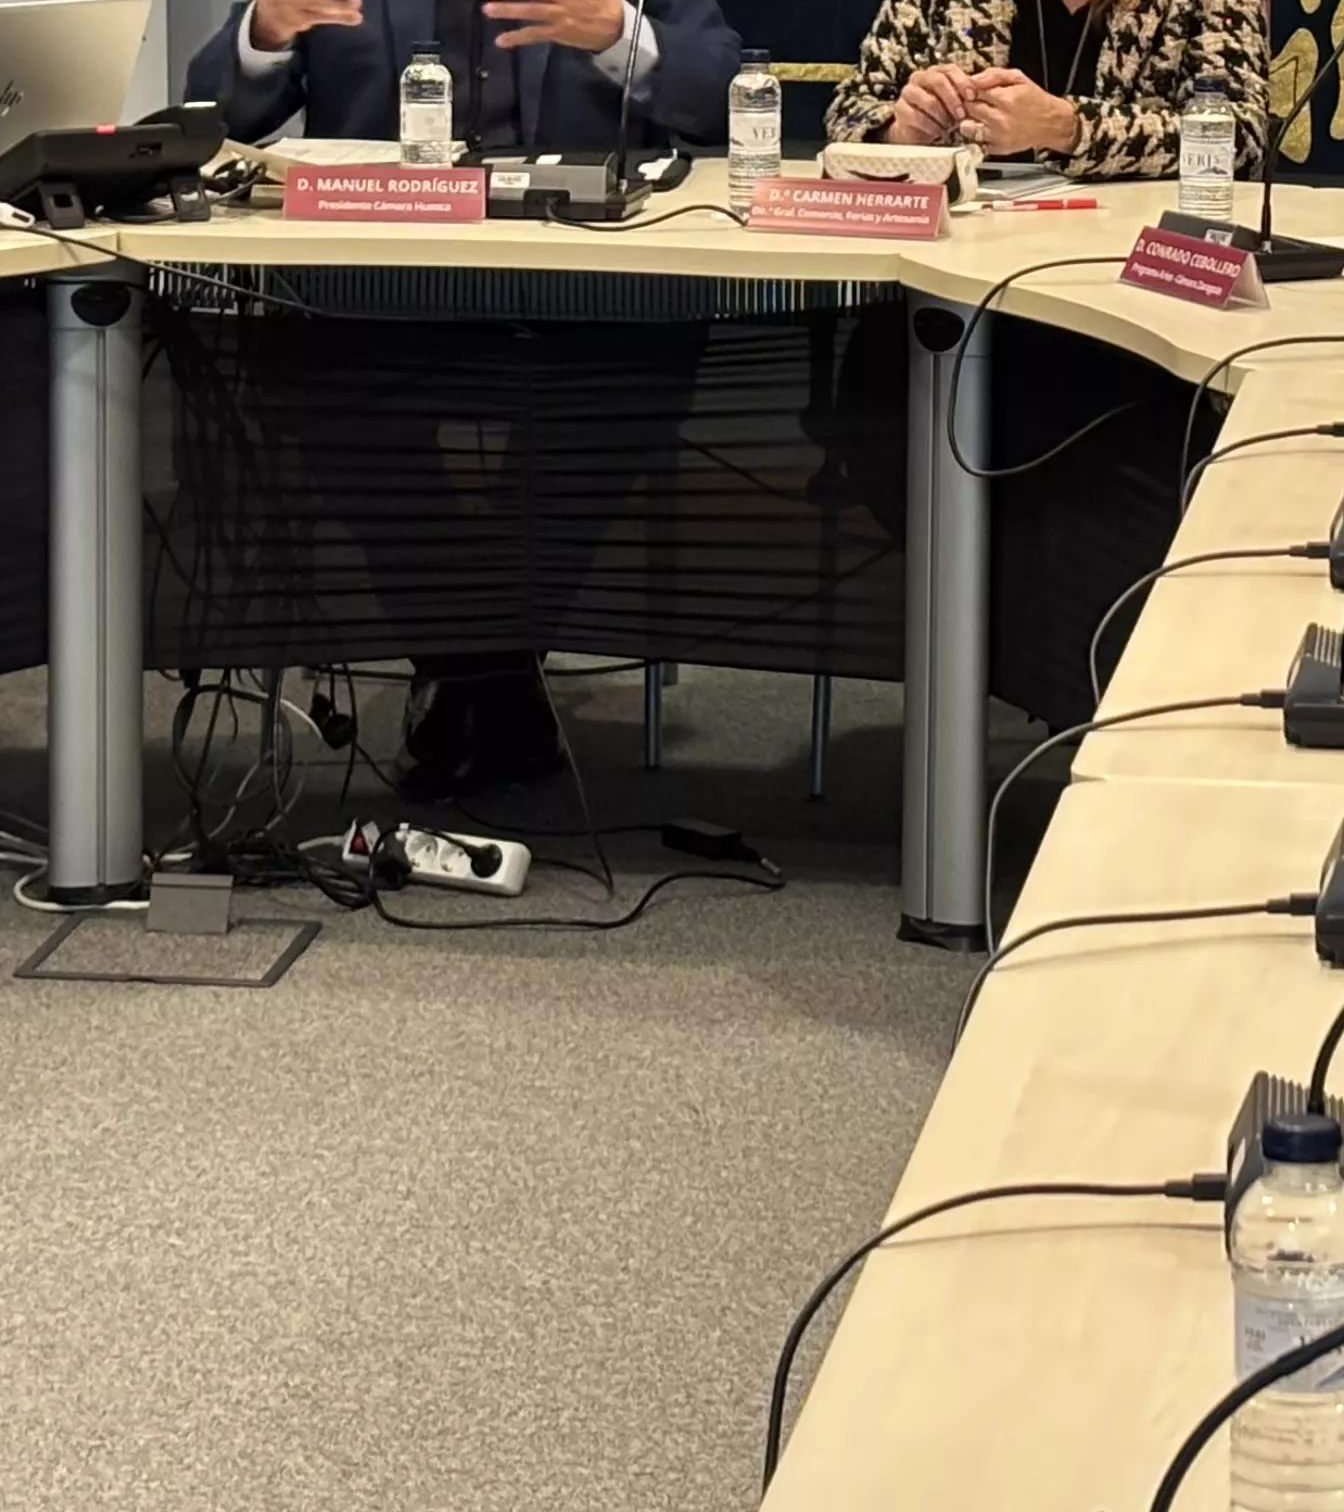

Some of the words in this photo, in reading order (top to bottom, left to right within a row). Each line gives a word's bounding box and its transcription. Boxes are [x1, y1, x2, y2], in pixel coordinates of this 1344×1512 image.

[297, 178, 313, 191] D.
[317, 178, 384, 192] MANUEL
[388, 176, 478, 194] RODRÍGUEZ
[792, 190, 853, 206] CARMEN
[856, 193, 929, 209] HERRARTE
[1146, 241, 1191, 265] CONRADO
